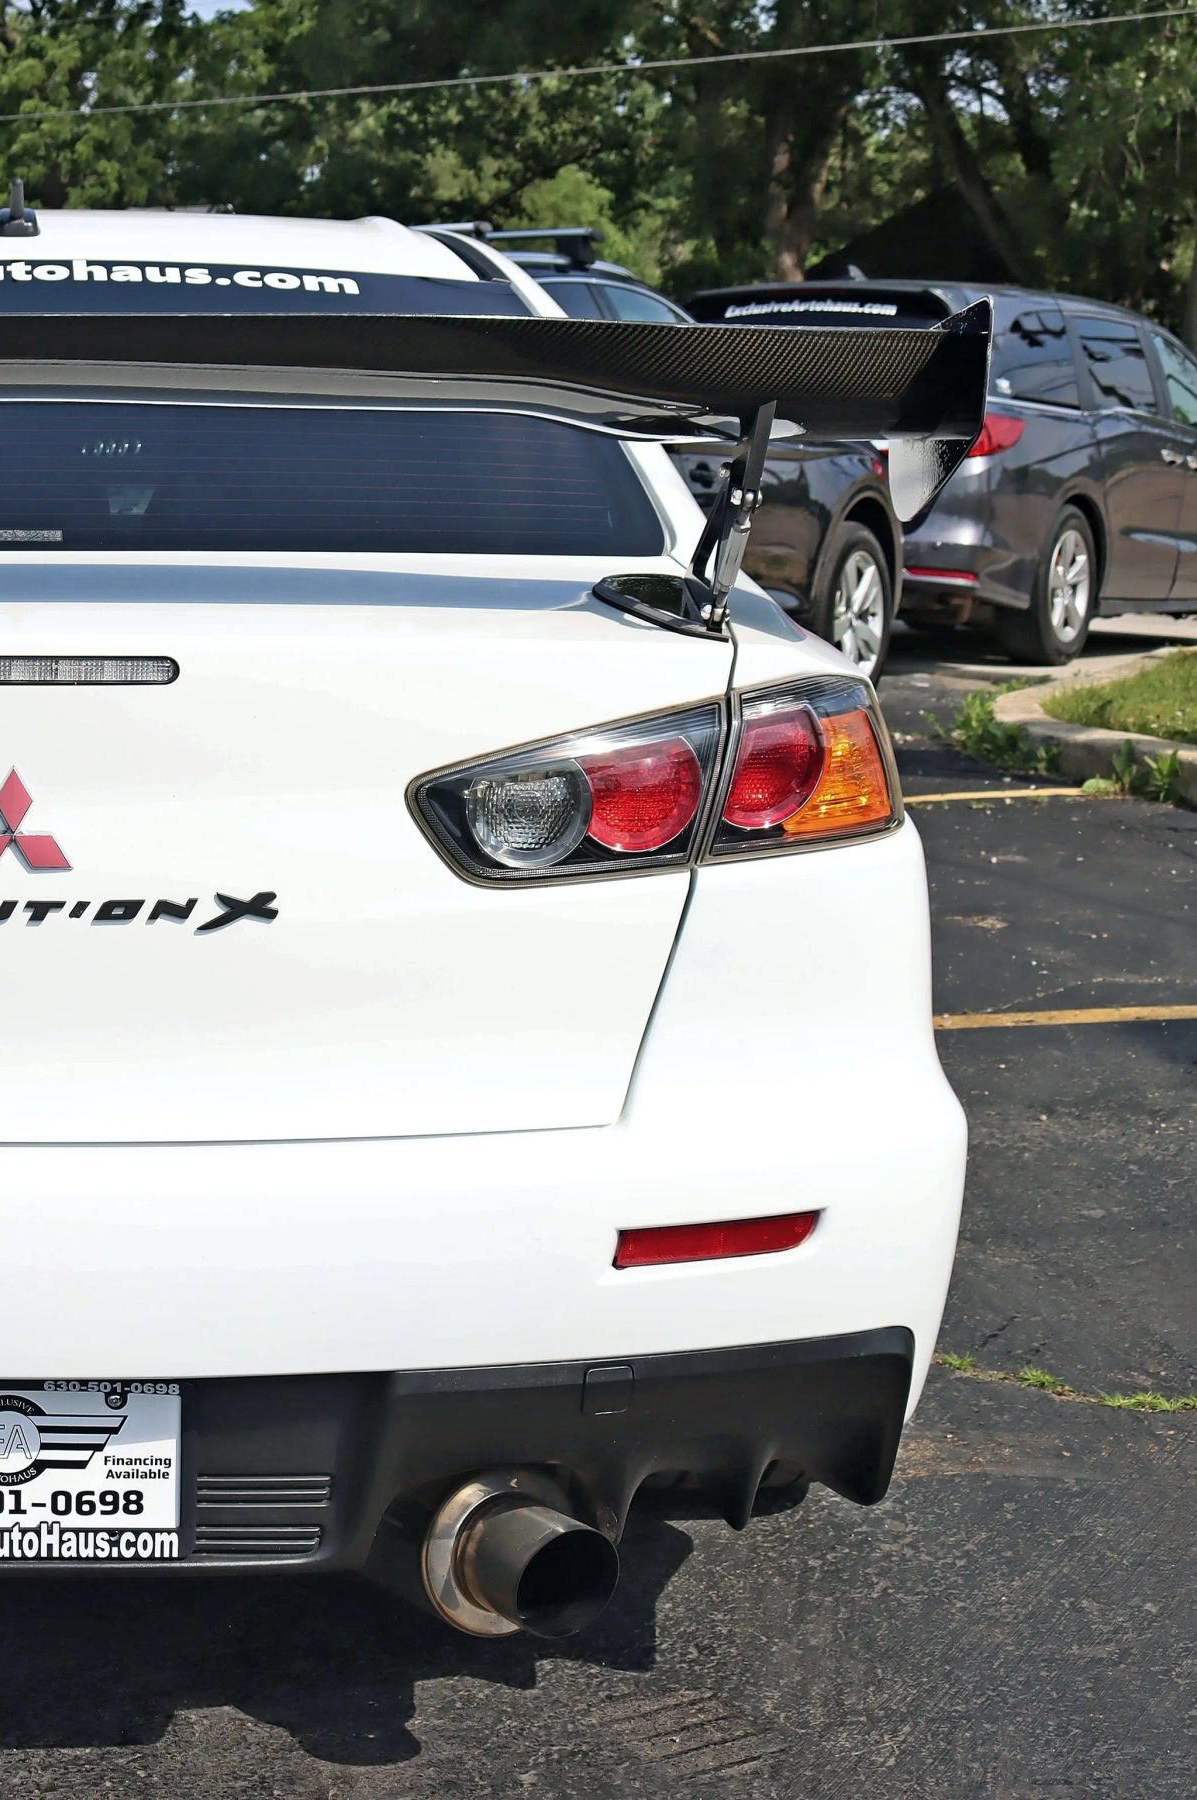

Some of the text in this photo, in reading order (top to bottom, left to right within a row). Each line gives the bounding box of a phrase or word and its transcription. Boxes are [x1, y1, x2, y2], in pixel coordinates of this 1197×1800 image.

[43, 1380, 180, 1395] 630-501-0698
[103, 1455, 172, 1469] Financing
[105, 1468, 170, 1480] Available
